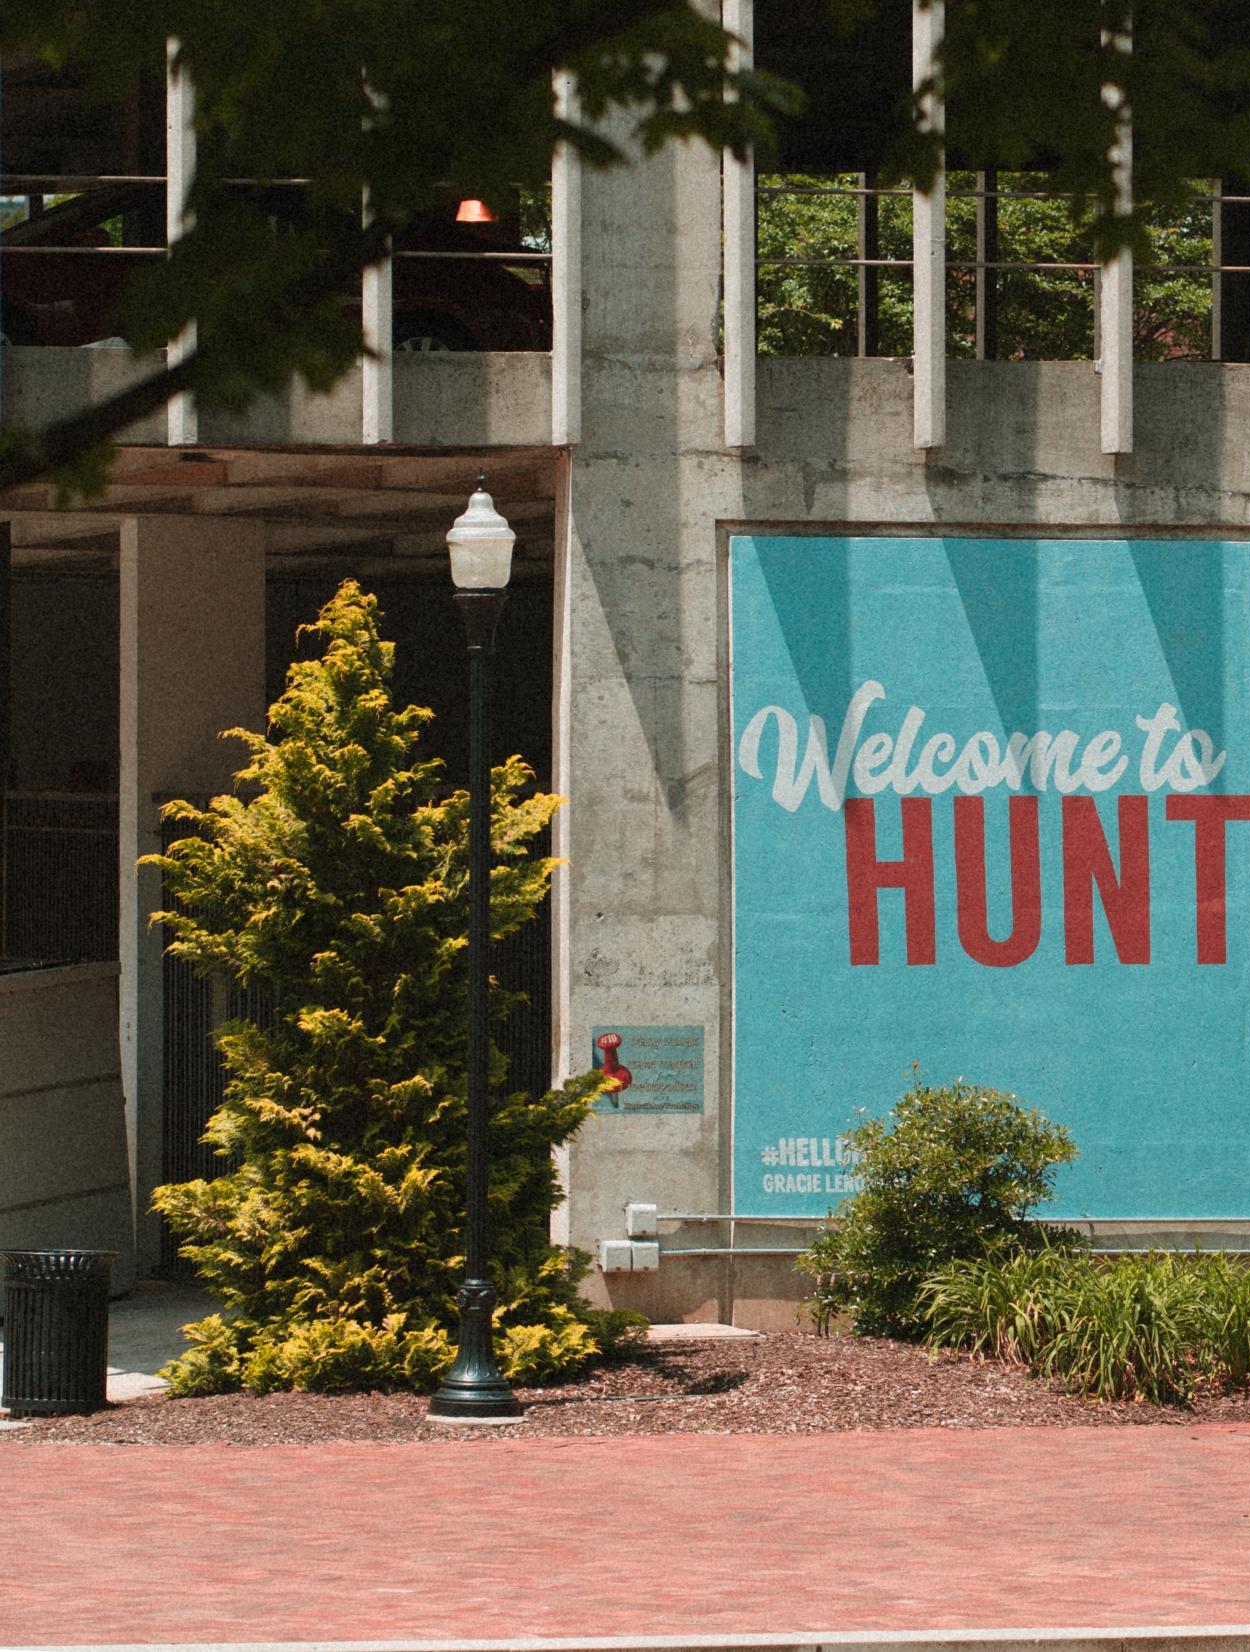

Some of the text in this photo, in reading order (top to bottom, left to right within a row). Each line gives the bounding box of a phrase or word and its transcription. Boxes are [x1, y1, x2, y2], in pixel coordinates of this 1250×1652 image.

[739, 679, 1226, 812] Welcome to
[761, 1137, 861, 1167] #HELLO
[763, 1173, 822, 1193] GRACIE
